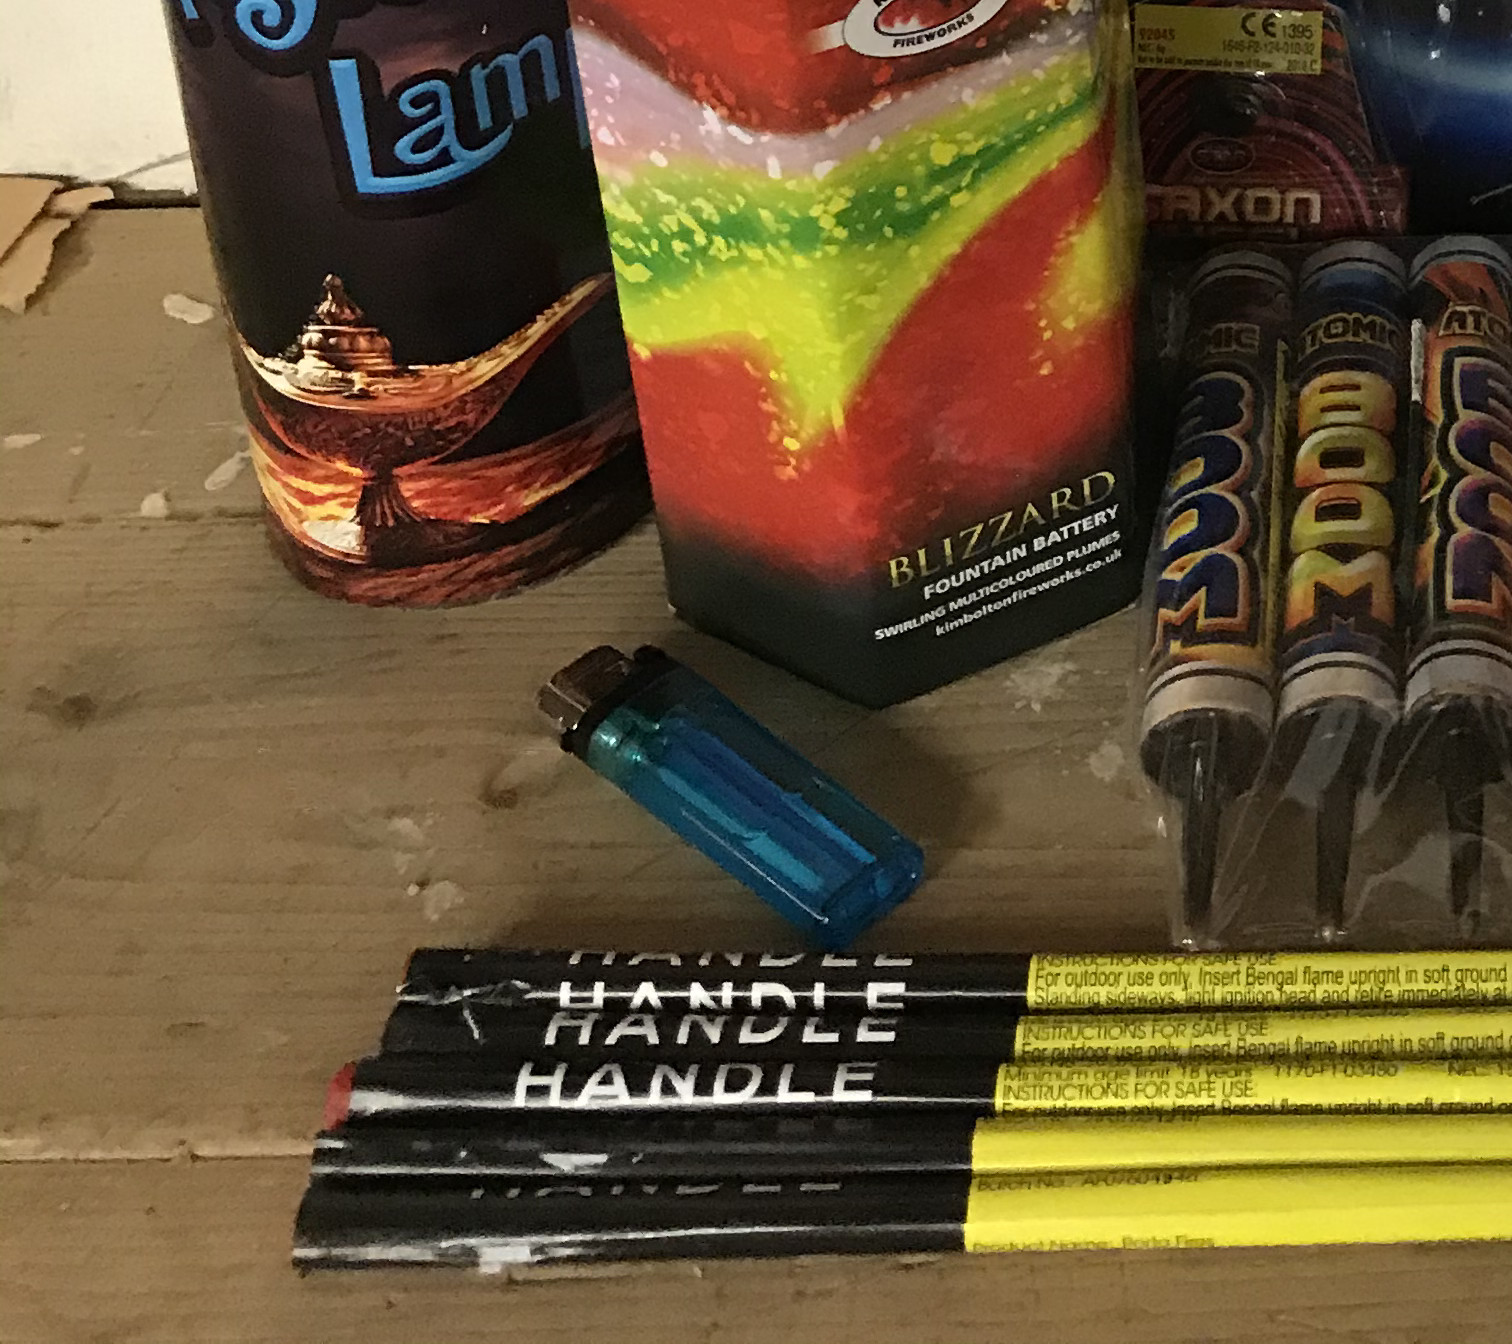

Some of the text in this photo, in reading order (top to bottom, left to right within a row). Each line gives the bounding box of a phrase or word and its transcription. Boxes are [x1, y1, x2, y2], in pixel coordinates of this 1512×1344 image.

[892, 13, 975, 49] FIREWORKS
[1282, 24, 1314, 39] 1395
[888, 470, 1116, 589] BLIZZARD
[923, 504, 1119, 600] FOUNTAIN BATTERY
[874, 530, 1121, 641] SWIRLING MULTICOLOURED PLUMES
[935, 548, 1123, 637] kimboltonfireworks.co.uk
[1035, 967, 1061, 987] For
[1065, 967, 1121, 987] outdoor
[1127, 969, 1154, 986] use
[1200, 966, 1242, 986] Insert
[1246, 966, 1298, 993] Bengal
[1302, 965, 1344, 985] flame
[1349, 964, 1401, 991] upright
[1405, 965, 1419, 983] in
[1423, 964, 1451, 984] soft
[1455, 964, 1508, 989] ground
[1023, 1020, 1269, 1041] INSTRUCTIONS FOR SAFE USE
[512, 1061, 879, 1106] HANDLE
[1002, 1079, 1255, 1101] INSTRUCTIONS FOR SAFE USE
